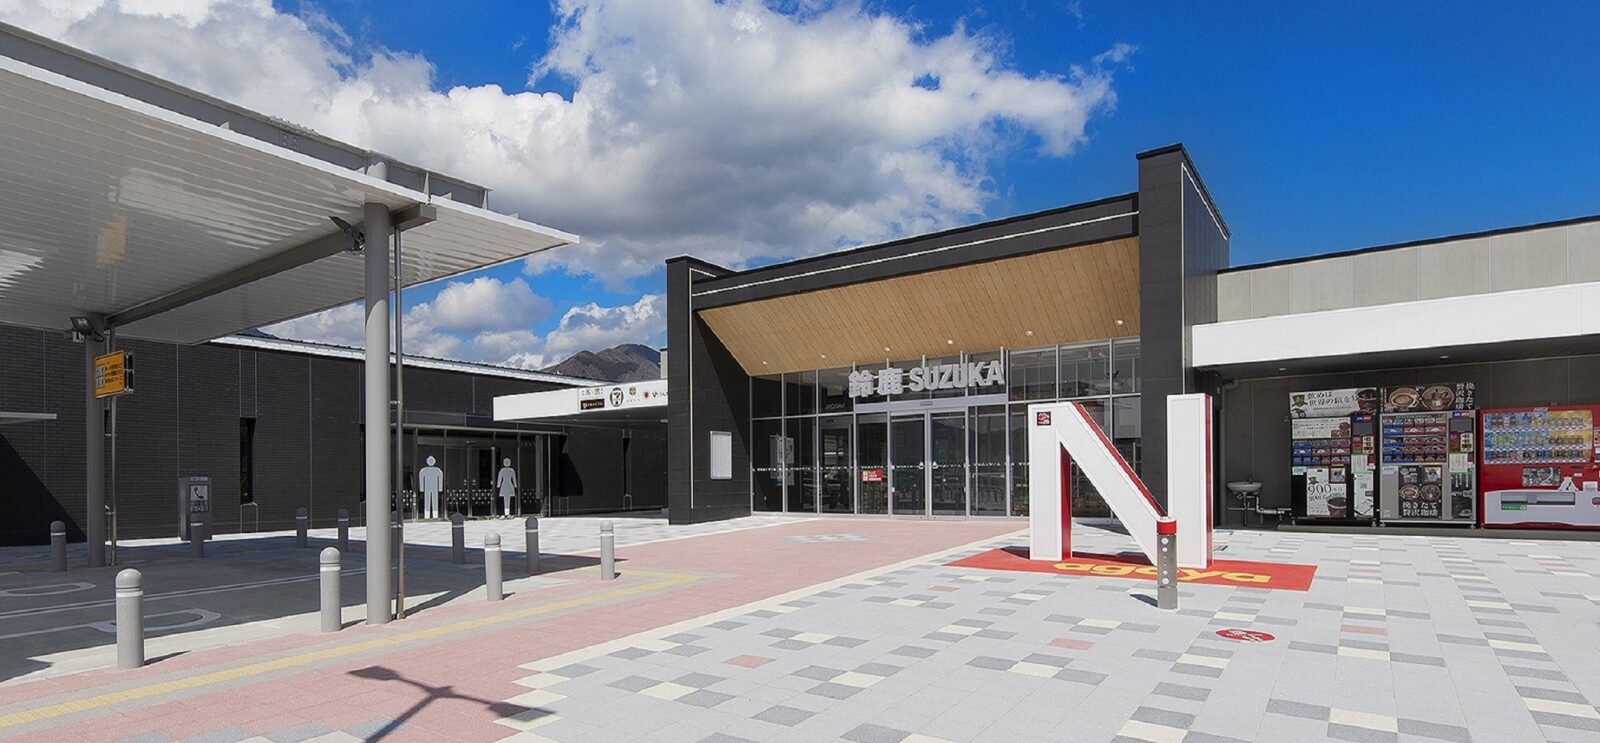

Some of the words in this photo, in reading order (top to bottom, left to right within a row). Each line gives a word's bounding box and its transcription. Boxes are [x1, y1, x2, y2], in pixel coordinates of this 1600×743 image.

[849, 369, 903, 397] 鈴鹿
[909, 360, 1006, 392] SUZUKA
[1028, 393, 1213, 568] N
[1308, 484, 1331, 495] 900
